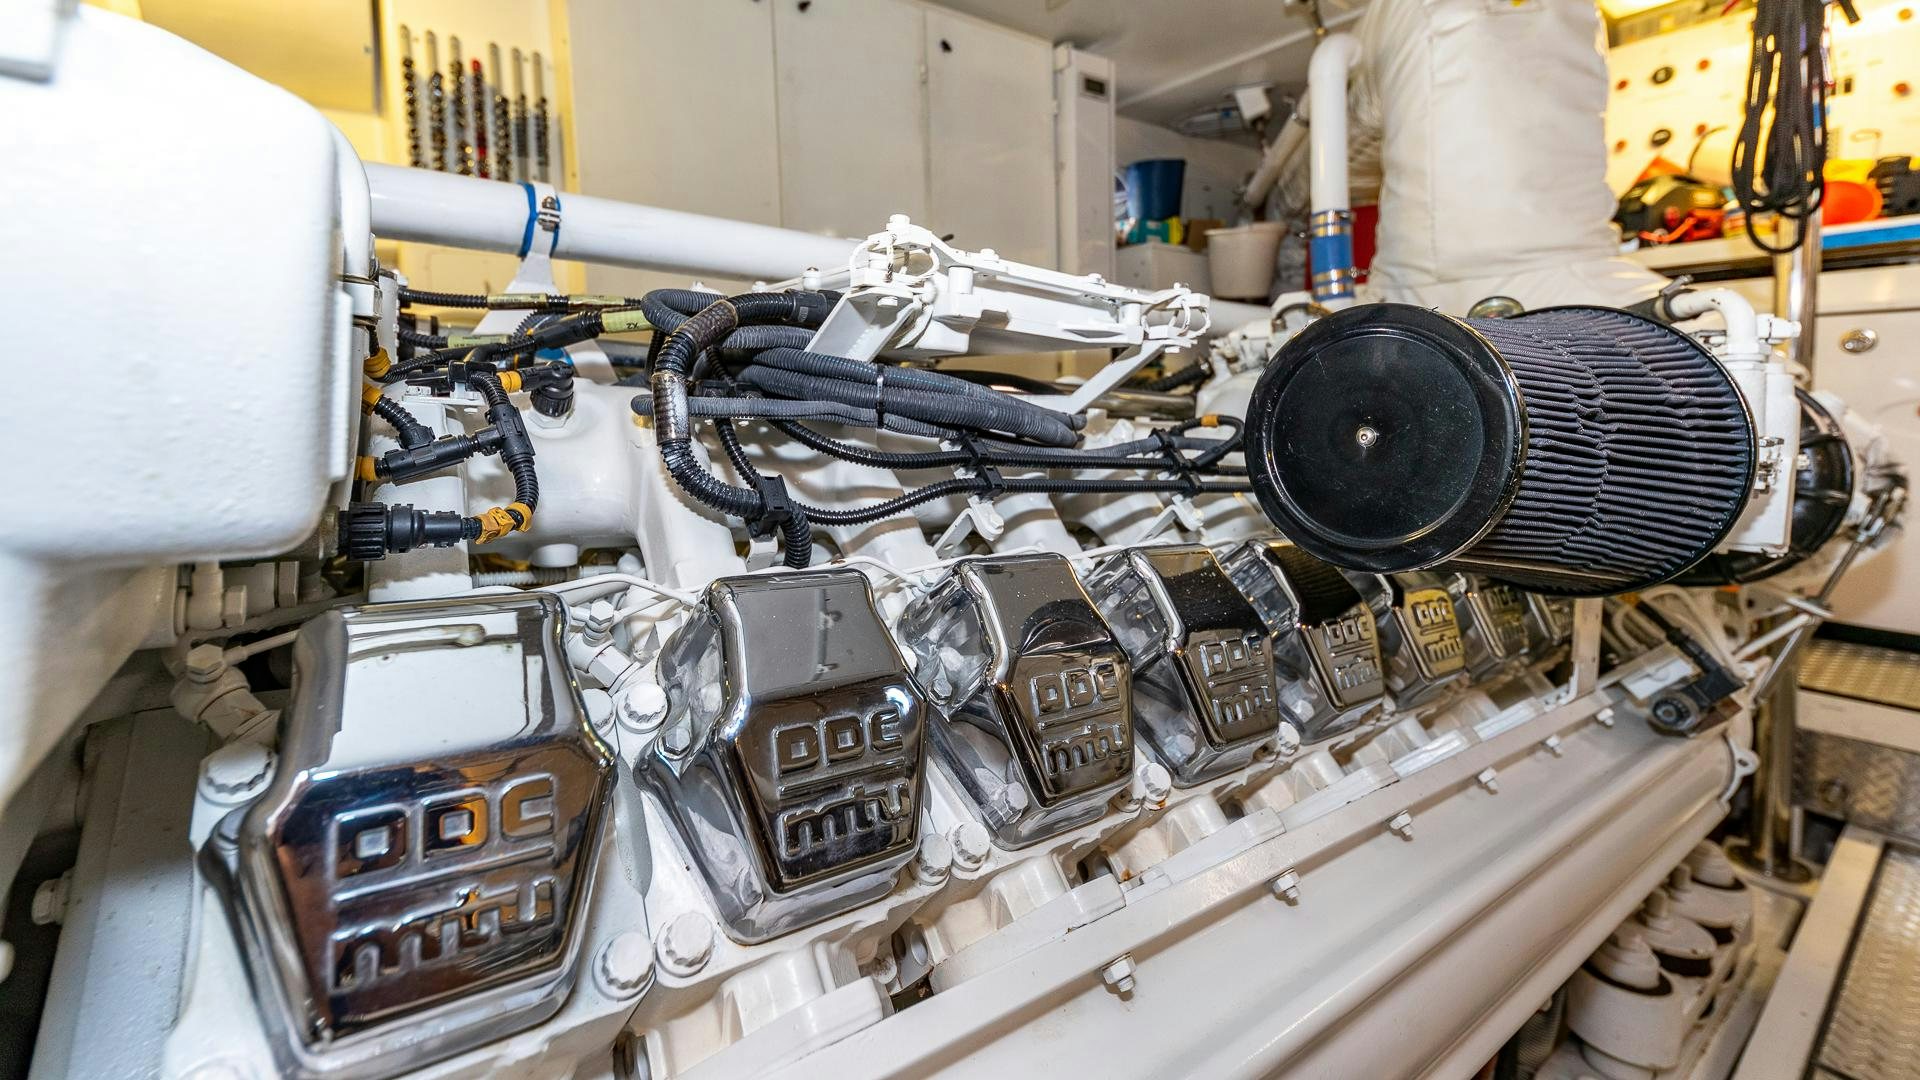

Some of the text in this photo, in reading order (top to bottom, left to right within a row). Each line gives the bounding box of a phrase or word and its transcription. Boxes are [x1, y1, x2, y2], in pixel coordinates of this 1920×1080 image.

[1321, 614, 1373, 650] DDC
[1412, 597, 1453, 628] DDC
[1200, 632, 1265, 678] DDC
[1030, 661, 1120, 717] DDC
[772, 706, 904, 779] DDC
[329, 772, 558, 882] DDC
[776, 779, 913, 860] mtu
[328, 875, 558, 993] mtu
